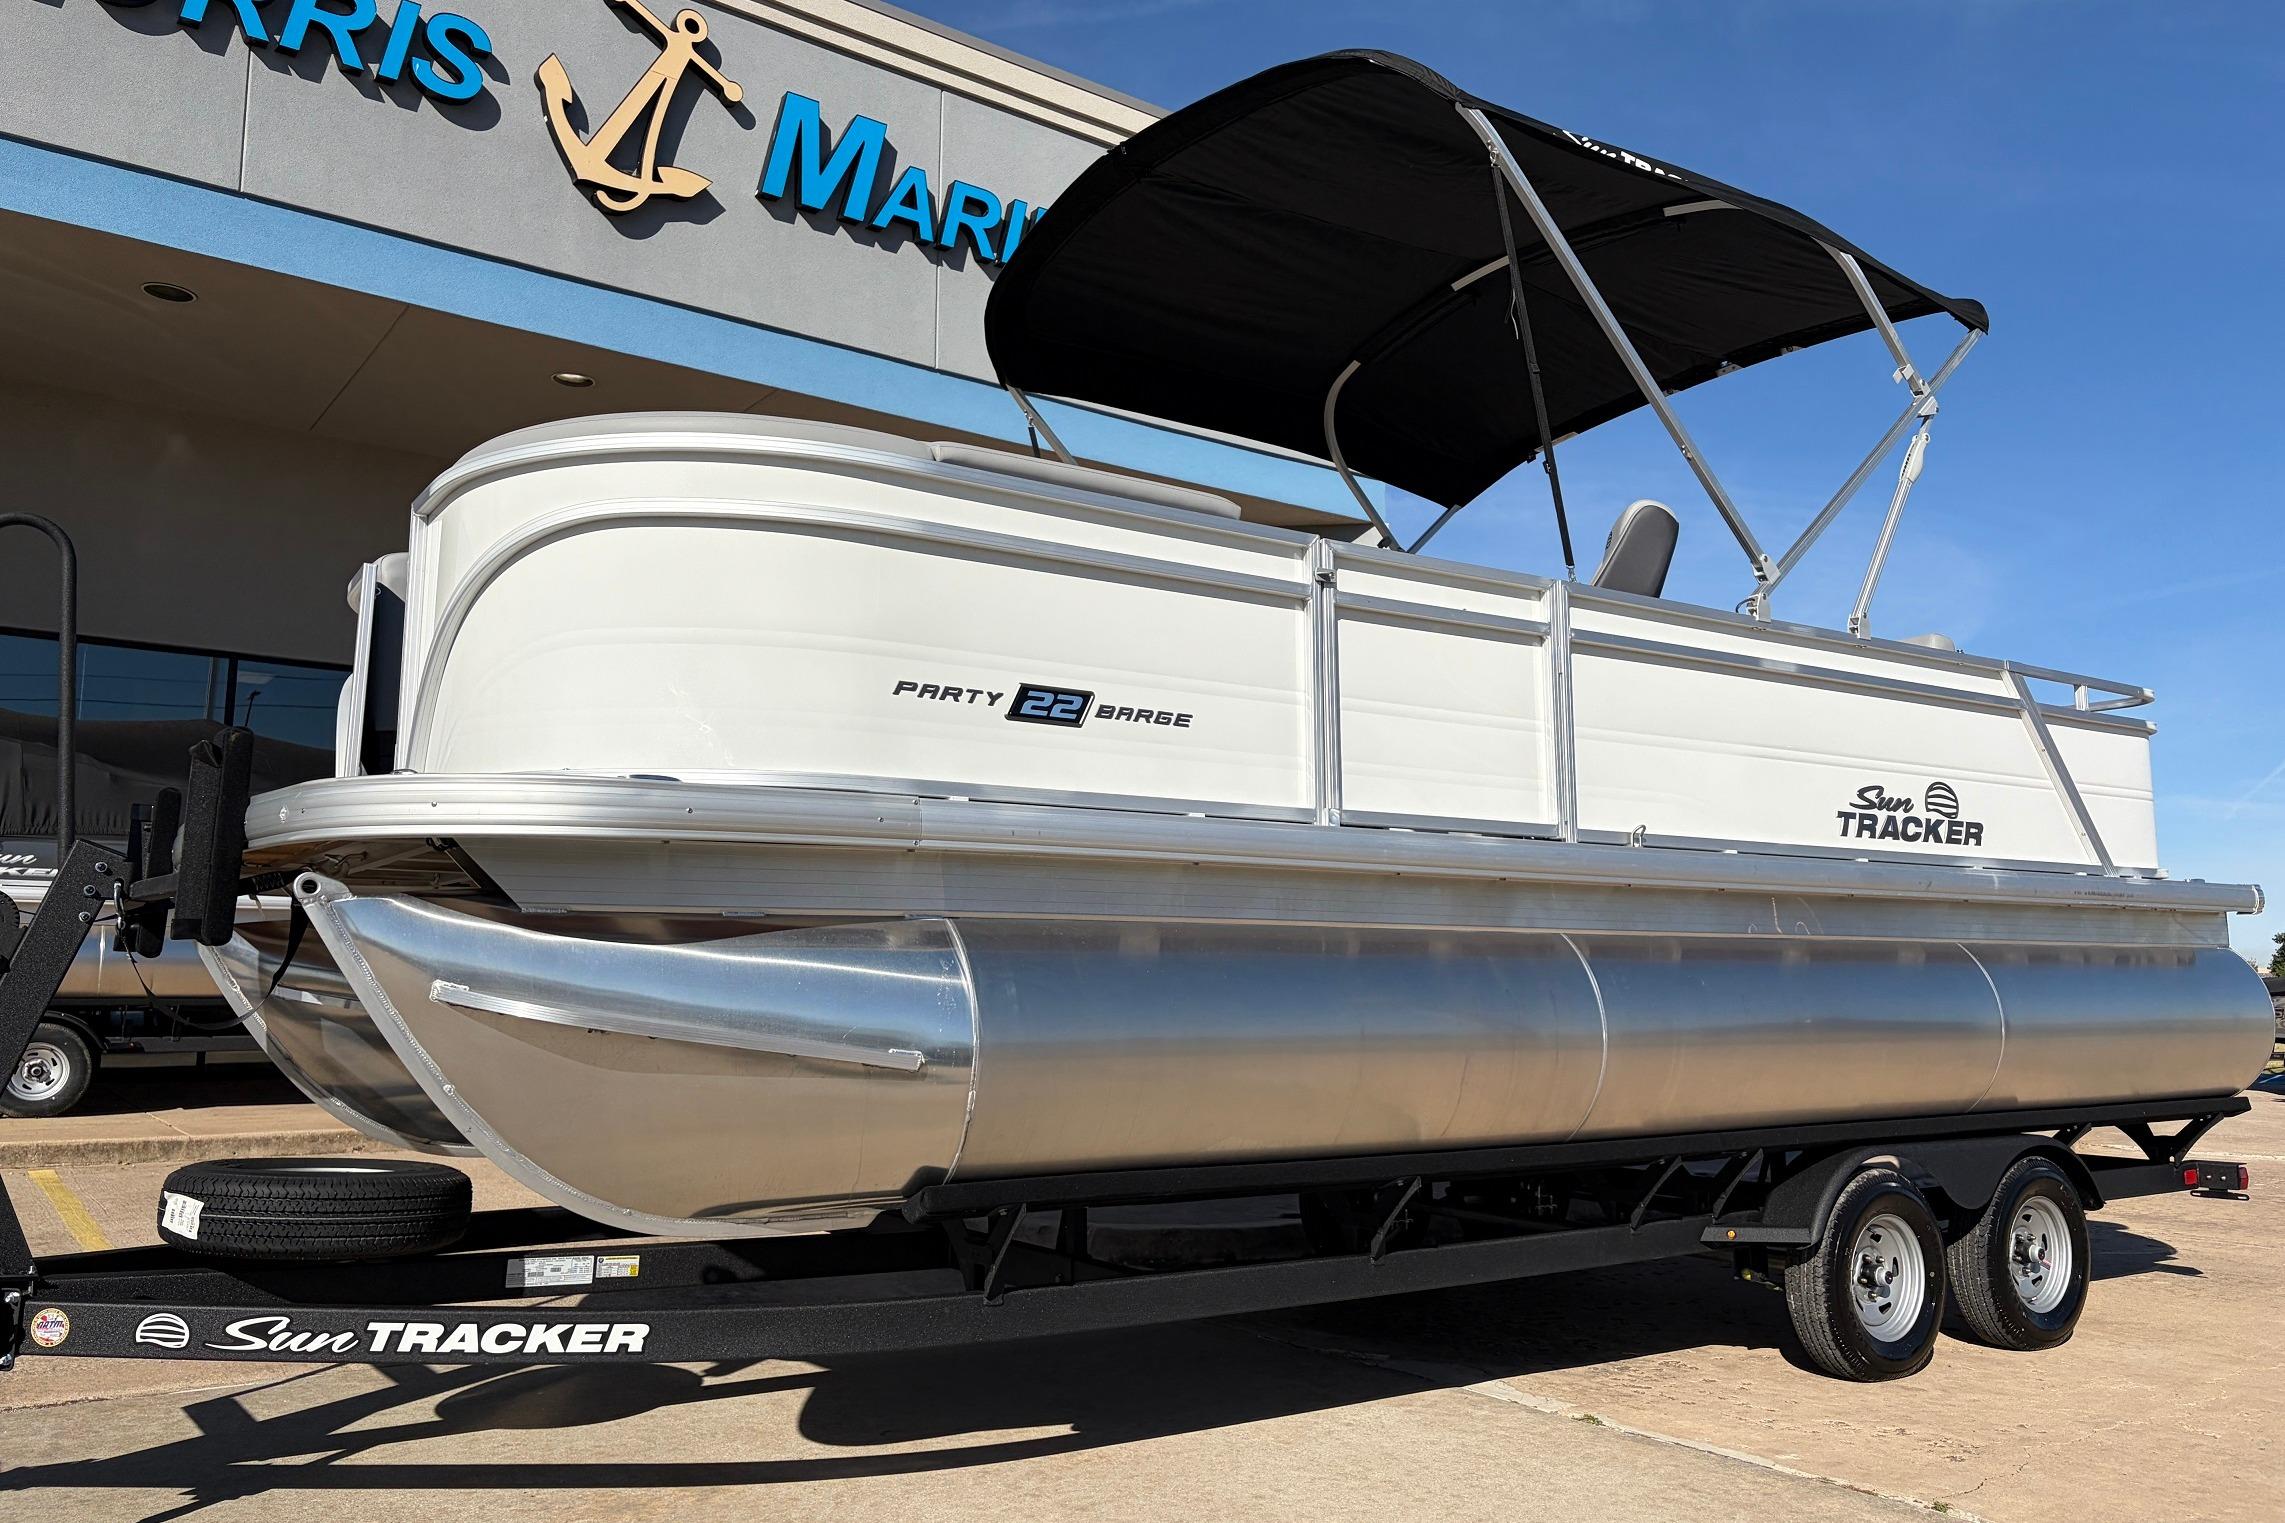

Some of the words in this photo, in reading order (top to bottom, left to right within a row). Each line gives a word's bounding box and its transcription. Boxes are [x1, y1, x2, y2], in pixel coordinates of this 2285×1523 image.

[757, 90, 1047, 265] MARI
[892, 680, 1004, 706] PARTY
[1020, 690, 1084, 720] 22
[1095, 704, 1194, 728] BARGE
[1849, 785, 1915, 813] Sun
[1836, 810, 1984, 846] TRACKER
[206, 1316, 359, 1352] Sun
[366, 1322, 651, 1353] TRACKER
